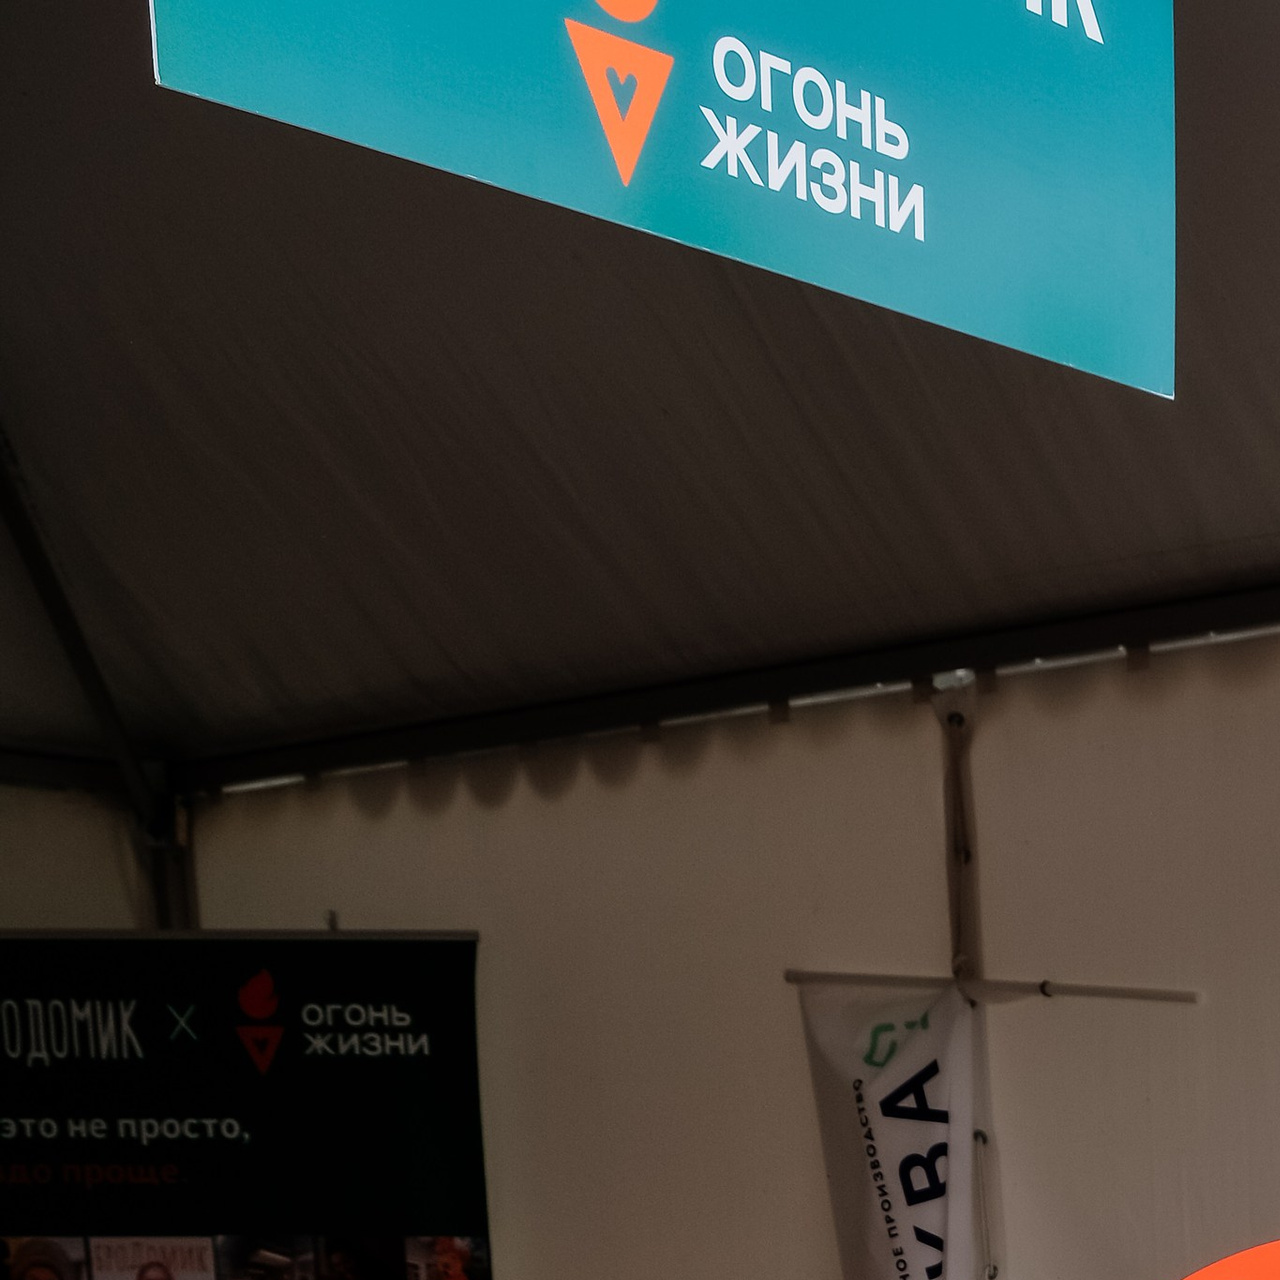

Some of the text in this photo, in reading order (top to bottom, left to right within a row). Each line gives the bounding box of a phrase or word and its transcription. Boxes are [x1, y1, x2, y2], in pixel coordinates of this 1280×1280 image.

[711, 35, 911, 161] ОГОНЬ
[698, 105, 926, 242] ЖИЗНИ
[301, 1003, 412, 1029] ОГОНЬ
[304, 1032, 430, 1057] ЖИЗНИ
[0, 1117, 251, 1146] это не просто,
[852, 1078, 898, 1239] ПРОИЗВОДСТВО
